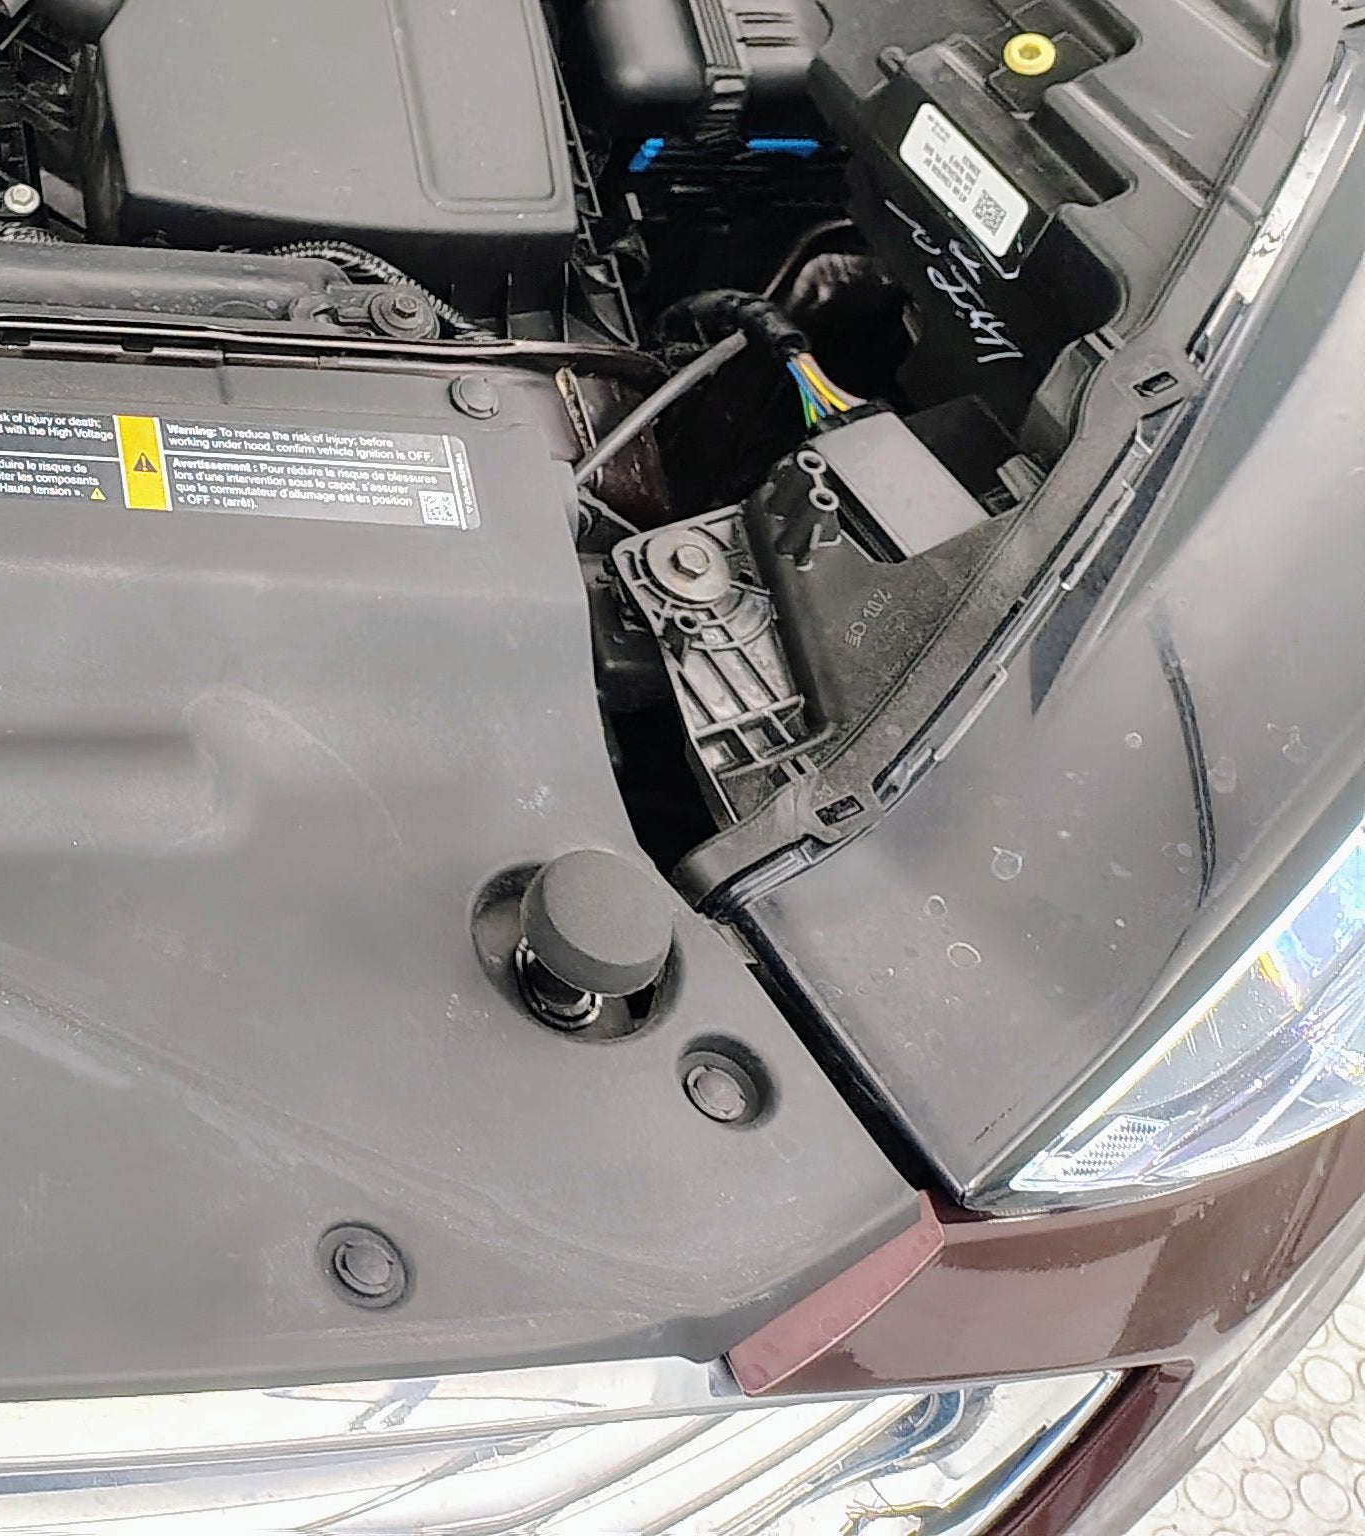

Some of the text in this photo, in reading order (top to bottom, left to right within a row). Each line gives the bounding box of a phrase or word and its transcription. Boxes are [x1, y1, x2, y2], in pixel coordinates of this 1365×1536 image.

[11, 413, 22, 422] of
[23, 414, 53, 426] injury
[54, 417, 66, 425] or
[4, 425, 26, 434] with
[27, 426, 46, 435] the
[47, 427, 72, 438] High
[75, 429, 113, 441] Voltage
[166, 424, 217, 438] Warning:
[218, 427, 232, 437] To
[234, 428, 271, 439] reduce
[272, 430, 290, 440] the
[291, 431, 311, 441] risk
[312, 433, 324, 442] of
[359, 436, 393, 447] before
[168, 436, 209, 450] working
[211, 438, 242, 449] under
[243, 441, 274, 454] hood,
[275, 442, 315, 454] confirm
[316, 445, 354, 456] vehicle
[355, 448, 394, 461] ignition
[407, 451, 433, 461] OFF.
[26, 460, 36, 471] le
[38, 461, 73, 475] risque
[74, 463, 87, 474] de
[172, 457, 251, 473] Avertissement
[259, 463, 285, 475] Pour
[286, 464, 324, 477] réduire
[325, 467, 335, 478] le
[336, 468, 370, 482] risque
[370, 470, 386, 481] de
[386, 471, 437, 484] blessures
[17, 472, 32, 482] les
[35, 473, 99, 488] composants
[173, 470, 193, 480] lors
[195, 471, 224, 482] d'une
[226, 473, 286, 486] intervention
[288, 479, 313, 487] sous
[314, 478, 325, 488] le
[361, 481, 409, 493] s'assurer
[32, 484, 72, 496] tension
[175, 482, 413, 508] que le commutateur d'allumage est en position
[186, 494, 211, 504] OFF
